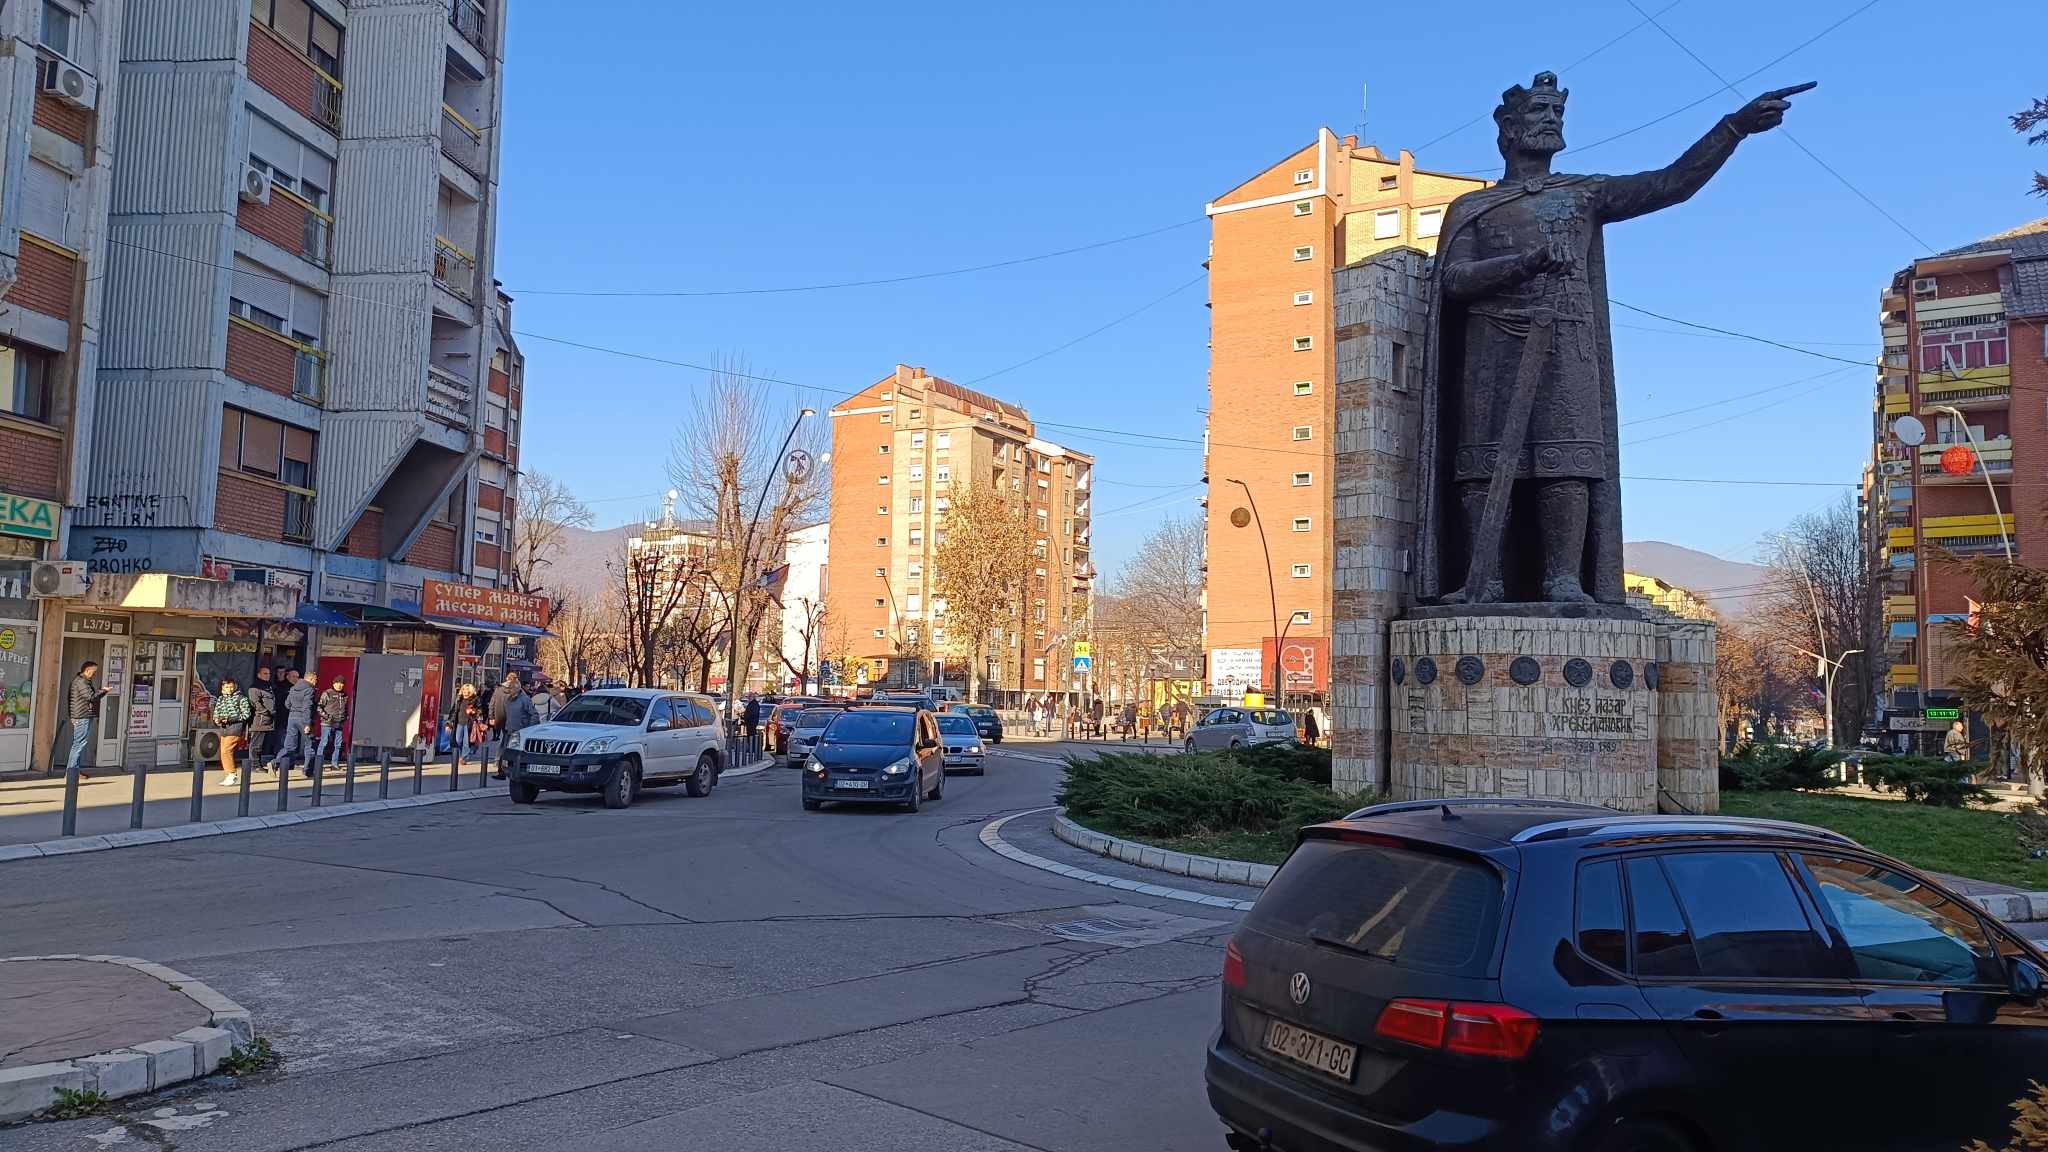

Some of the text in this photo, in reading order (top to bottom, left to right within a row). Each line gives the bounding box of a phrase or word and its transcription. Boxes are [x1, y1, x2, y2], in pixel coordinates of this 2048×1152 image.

[434, 583, 542, 609] СУПЕР МАРКЕТ
[435, 599, 540, 624] МЕСАРА ЛАЗИЋ
[83, 618, 111, 631] L3/79
[1562, 697, 1591, 714] КНЕЗ
